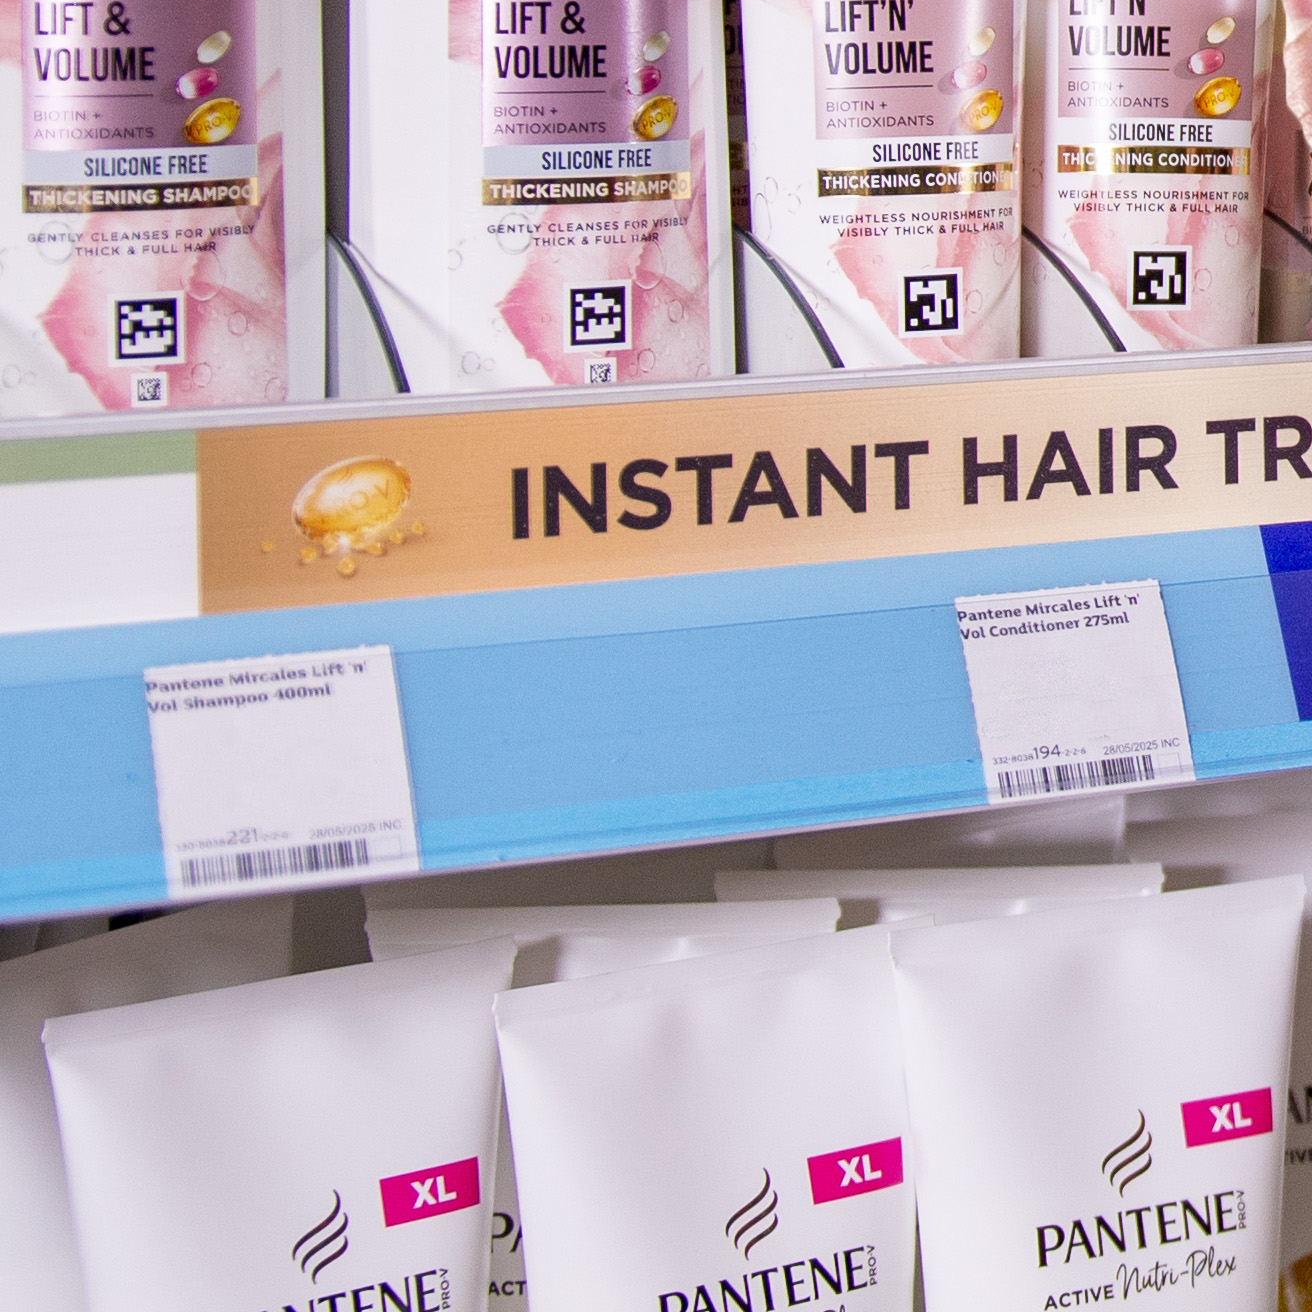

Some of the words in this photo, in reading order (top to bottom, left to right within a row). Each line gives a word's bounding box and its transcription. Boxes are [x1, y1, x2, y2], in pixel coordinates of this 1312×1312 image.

[33, 0, 95, 36] LIFT
[102, 0, 132, 37] &
[494, 0, 552, 36] LIFT
[559, 0, 586, 35] &
[1067, 25, 1172, 59] VOLUME
[33, 45, 156, 82] VOLUME
[493, 43, 608, 80] VOLUME
[824, 40, 935, 76] VOLUME
[1066, 81, 1113, 92] BIOTIN
[33, 109, 87, 123] BIOTIN
[492, 104, 546, 119] BIOTIN
[825, 100, 875, 113] BIOTIN
[33, 125, 156, 141] ANTIOXIDANTS
[493, 120, 607, 136] ANTIOXIDANTS
[825, 114, 935, 129] ANTIOXIDANTS
[1108, 123, 1175, 141] SILICONE
[1179, 124, 1214, 143] FREE
[541, 149, 614, 172] SILICONE
[617, 147, 653, 169] FREE
[872, 142, 942, 163] SILICONE
[945, 140, 980, 161] FREE
[1062, 151, 1153, 167] THICNING
[83, 155, 163, 178] SILICONE
[167, 153, 208, 176] FREE
[489, 181, 610, 201] THICKENING
[613, 178, 690, 197] SHAMPOO
[822, 172, 921, 190] THICKENING
[29, 187, 158, 207] THICKENING
[162, 183, 254, 204] SHAMPOO
[1142, 190, 1230, 201] NOURISHMENT
[818, 213, 907, 225] WEIGHTLESS
[910, 209, 996, 222] NOURISHMENT
[998, 206, 1014, 218] FOR
[27, 231, 84, 244] GENTLY
[90, 229, 170, 243] CLEANSES
[174, 227, 205, 240] FOR
[208, 224, 256, 238] VISIBLY
[486, 222, 542, 236] GENTLY
[547, 221, 620, 234] CLEANSES
[836, 226, 889, 238] VISIBLY
[894, 224, 935, 237] THICK
[950, 222, 979, 234] FULL
[981, 220, 1005, 233] HAIR
[74, 244, 122, 257] THICK
[141, 242, 180, 255] FULL
[183, 240, 218, 254] HAIR
[511, 440, 929, 540] INSTANT
[961, 424, 1179, 506] HAIR
[957, 606, 1022, 623] Pantene
[1025, 598, 1091, 616] Mircales
[1094, 594, 1122, 608] Lift
[960, 627, 986, 640] Vol
[989, 618, 1080, 637] Conditioner
[1084, 611, 1130, 627] 275ml
[145, 675, 225, 695] Pantene
[229, 667, 307, 686] Mircales
[312, 662, 345, 678] Lift
[148, 698, 178, 714] Vol
[183, 691, 269, 711] Shampoo
[274, 683, 333, 700] 400ml
[1103, 739, 1159, 756] 28/05/2025
[1161, 737, 1181, 749] INC
[1208, 1102, 1253, 1134] XL
[837, 1153, 883, 1189] XL
[410, 1175, 458, 1210] XL
[1035, 1190, 1239, 1269] PANTENE
[865, 1244, 879, 1287] PRO-V
[1043, 1284, 1115, 1312] ACTIVE
[1116, 1246, 1238, 1301] Nutri-Plex
